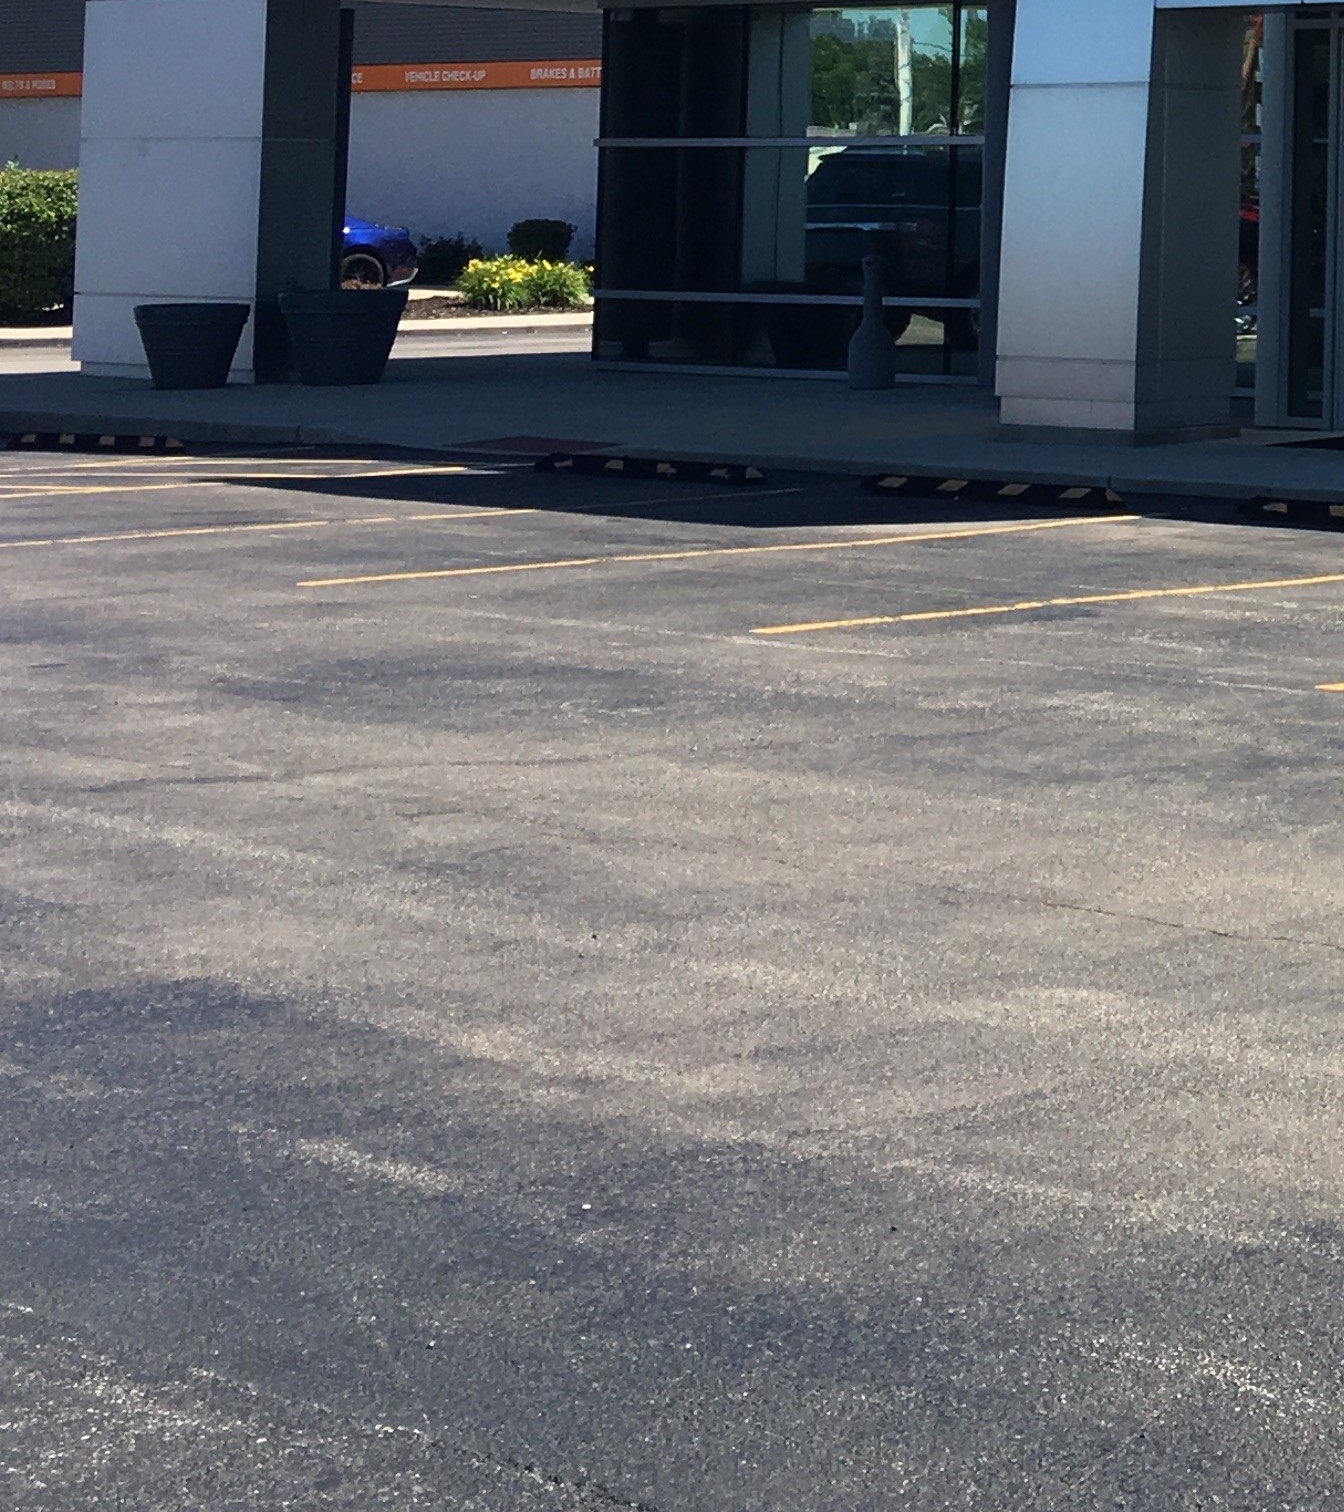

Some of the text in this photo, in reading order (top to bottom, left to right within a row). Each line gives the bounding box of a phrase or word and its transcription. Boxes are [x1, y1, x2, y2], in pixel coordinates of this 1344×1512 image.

[405, 70, 486, 83] VEHICLE CHECK-UP
[530, 68, 567, 80] BRAKES
